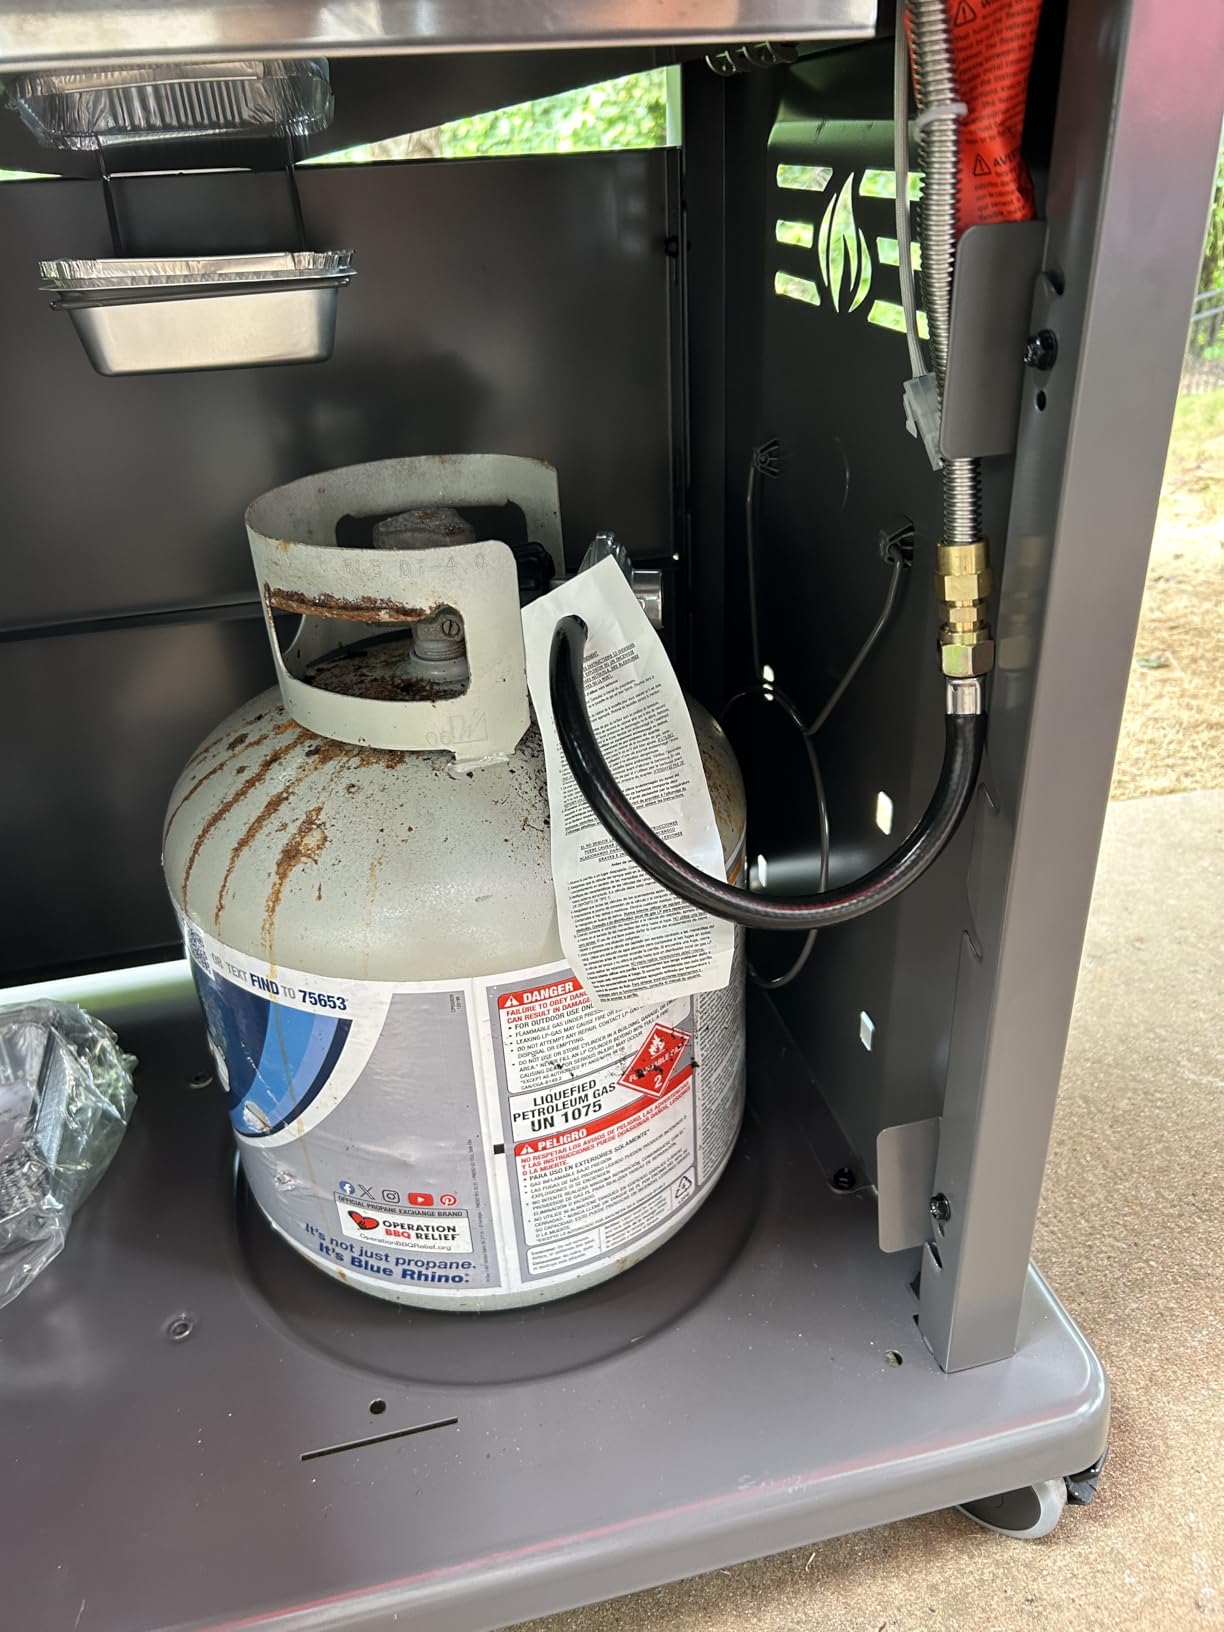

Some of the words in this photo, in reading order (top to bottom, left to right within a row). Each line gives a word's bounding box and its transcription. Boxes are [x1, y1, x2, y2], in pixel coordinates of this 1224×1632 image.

[212, 953, 223, 968] OR
[226, 962, 247, 981] TEXT
[250, 973, 279, 995] FIND
[281, 985, 296, 999] TO
[299, 989, 347, 1011] 75653
[523, 981, 574, 1003] DANGER
[506, 1004, 536, 1017] FAILURE
[550, 997, 567, 1006] OBEY
[507, 1015, 522, 1024] CAN
[524, 1008, 550, 1020] RESULT
[514, 1021, 529, 1030] FOR
[531, 1012, 564, 1026] OUTDOOR
[566, 1007, 579, 1015] USE
[581, 1003, 593, 1011] ONL
[533, 1079, 597, 1107] LIQUEFIED
[654, 1074, 662, 1089] 2
[513, 1093, 589, 1122] PETROLEUM
[593, 1082, 616, 1099] GAS
[531, 1115, 555, 1132] UN
[561, 1100, 602, 1123] 1075
[538, 1128, 588, 1151] PELIGRO
[529, 1172, 547, 1180] PARA
[549, 1167, 562, 1175] USO
[574, 1151, 614, 1167] EXTERIORES
[338, 1194, 365, 1208] OFFICIAL
[367, 1202, 398, 1213] PROPANE
[398, 1209, 436, 1217] EXCHANGE
[382, 1220, 457, 1233] OPERATION
[384, 1228, 411, 1240] BBQ
[416, 1232, 457, 1241] RELIEF
[305, 1223, 326, 1241] It's
[330, 1237, 354, 1251] not
[358, 1246, 390, 1263] just
[395, 1257, 476, 1271] propane.
[359, 1233, 452, 1251] OperationBBQRelief.org
[319, 1243, 344, 1262] It's
[351, 1255, 394, 1277] Blue
